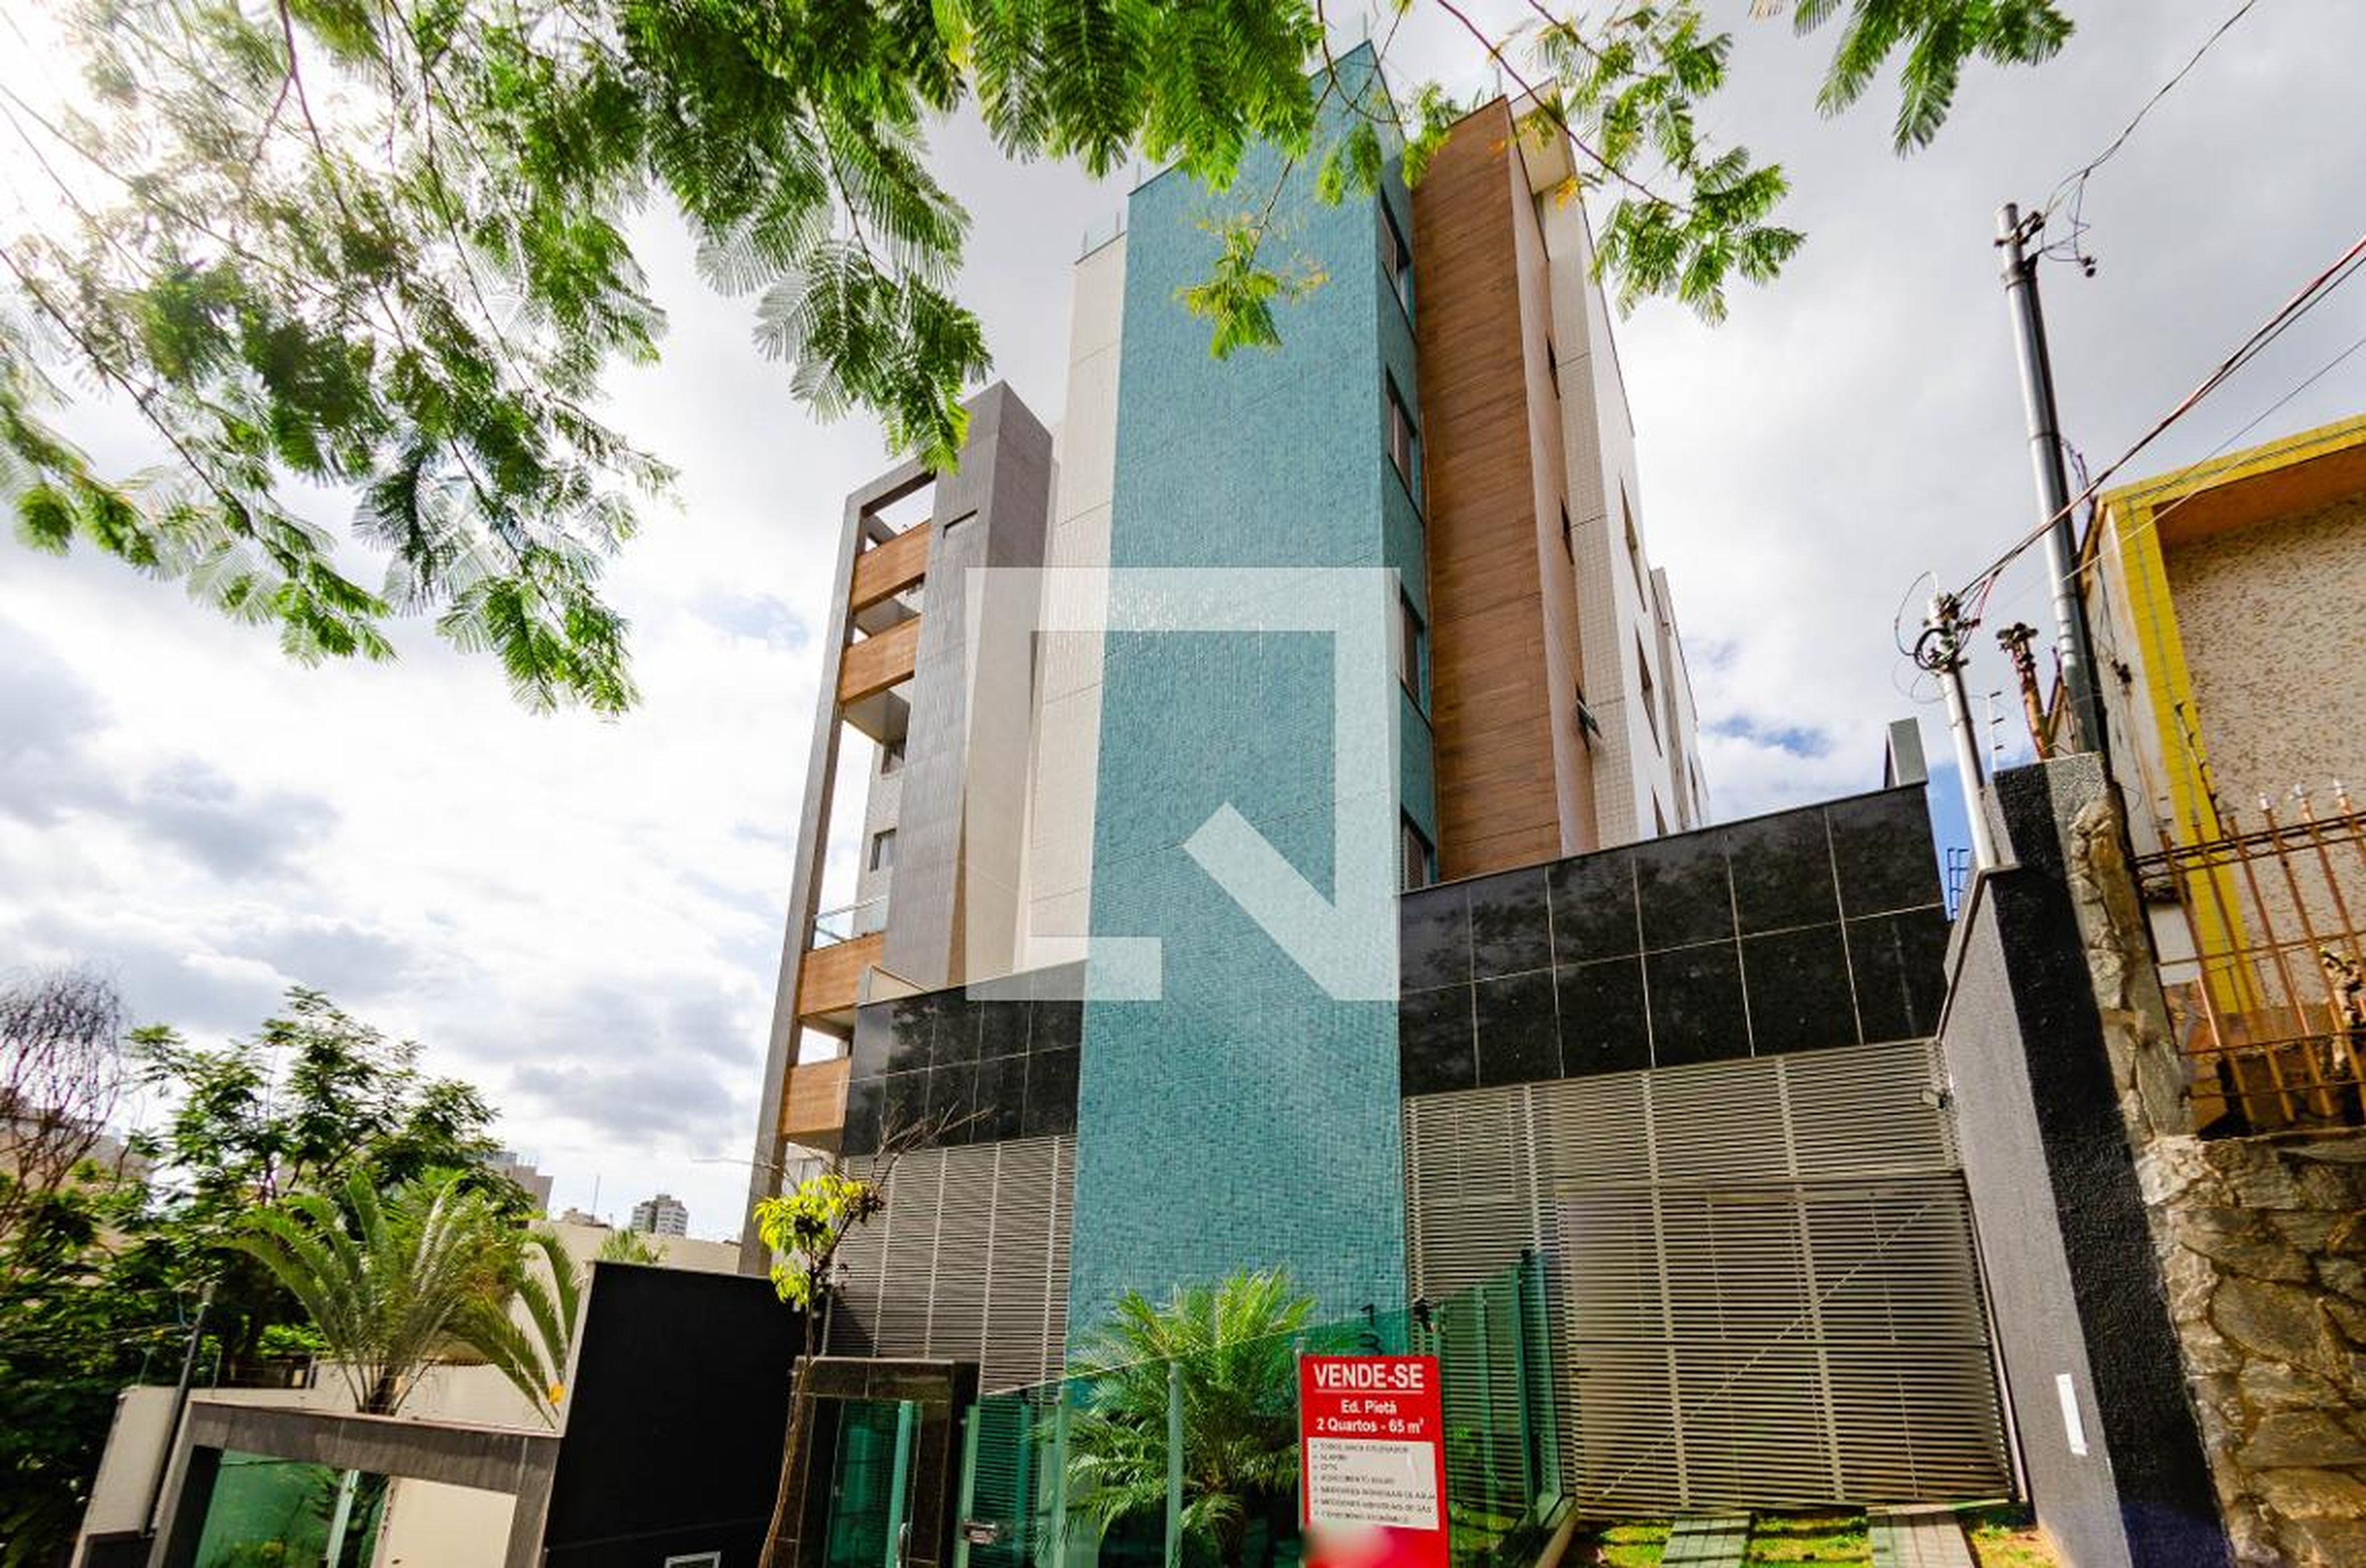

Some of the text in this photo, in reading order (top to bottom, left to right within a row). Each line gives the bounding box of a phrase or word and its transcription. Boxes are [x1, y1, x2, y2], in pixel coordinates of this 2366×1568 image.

[1313, 1363, 1424, 1388] VENDE-SE
[1342, 1400, 1361, 1413] Ed.
[1317, 1418, 1323, 1431] 2
[1328, 1418, 1377, 1432] Quartos
[1389, 1419, 1404, 1432] 65
